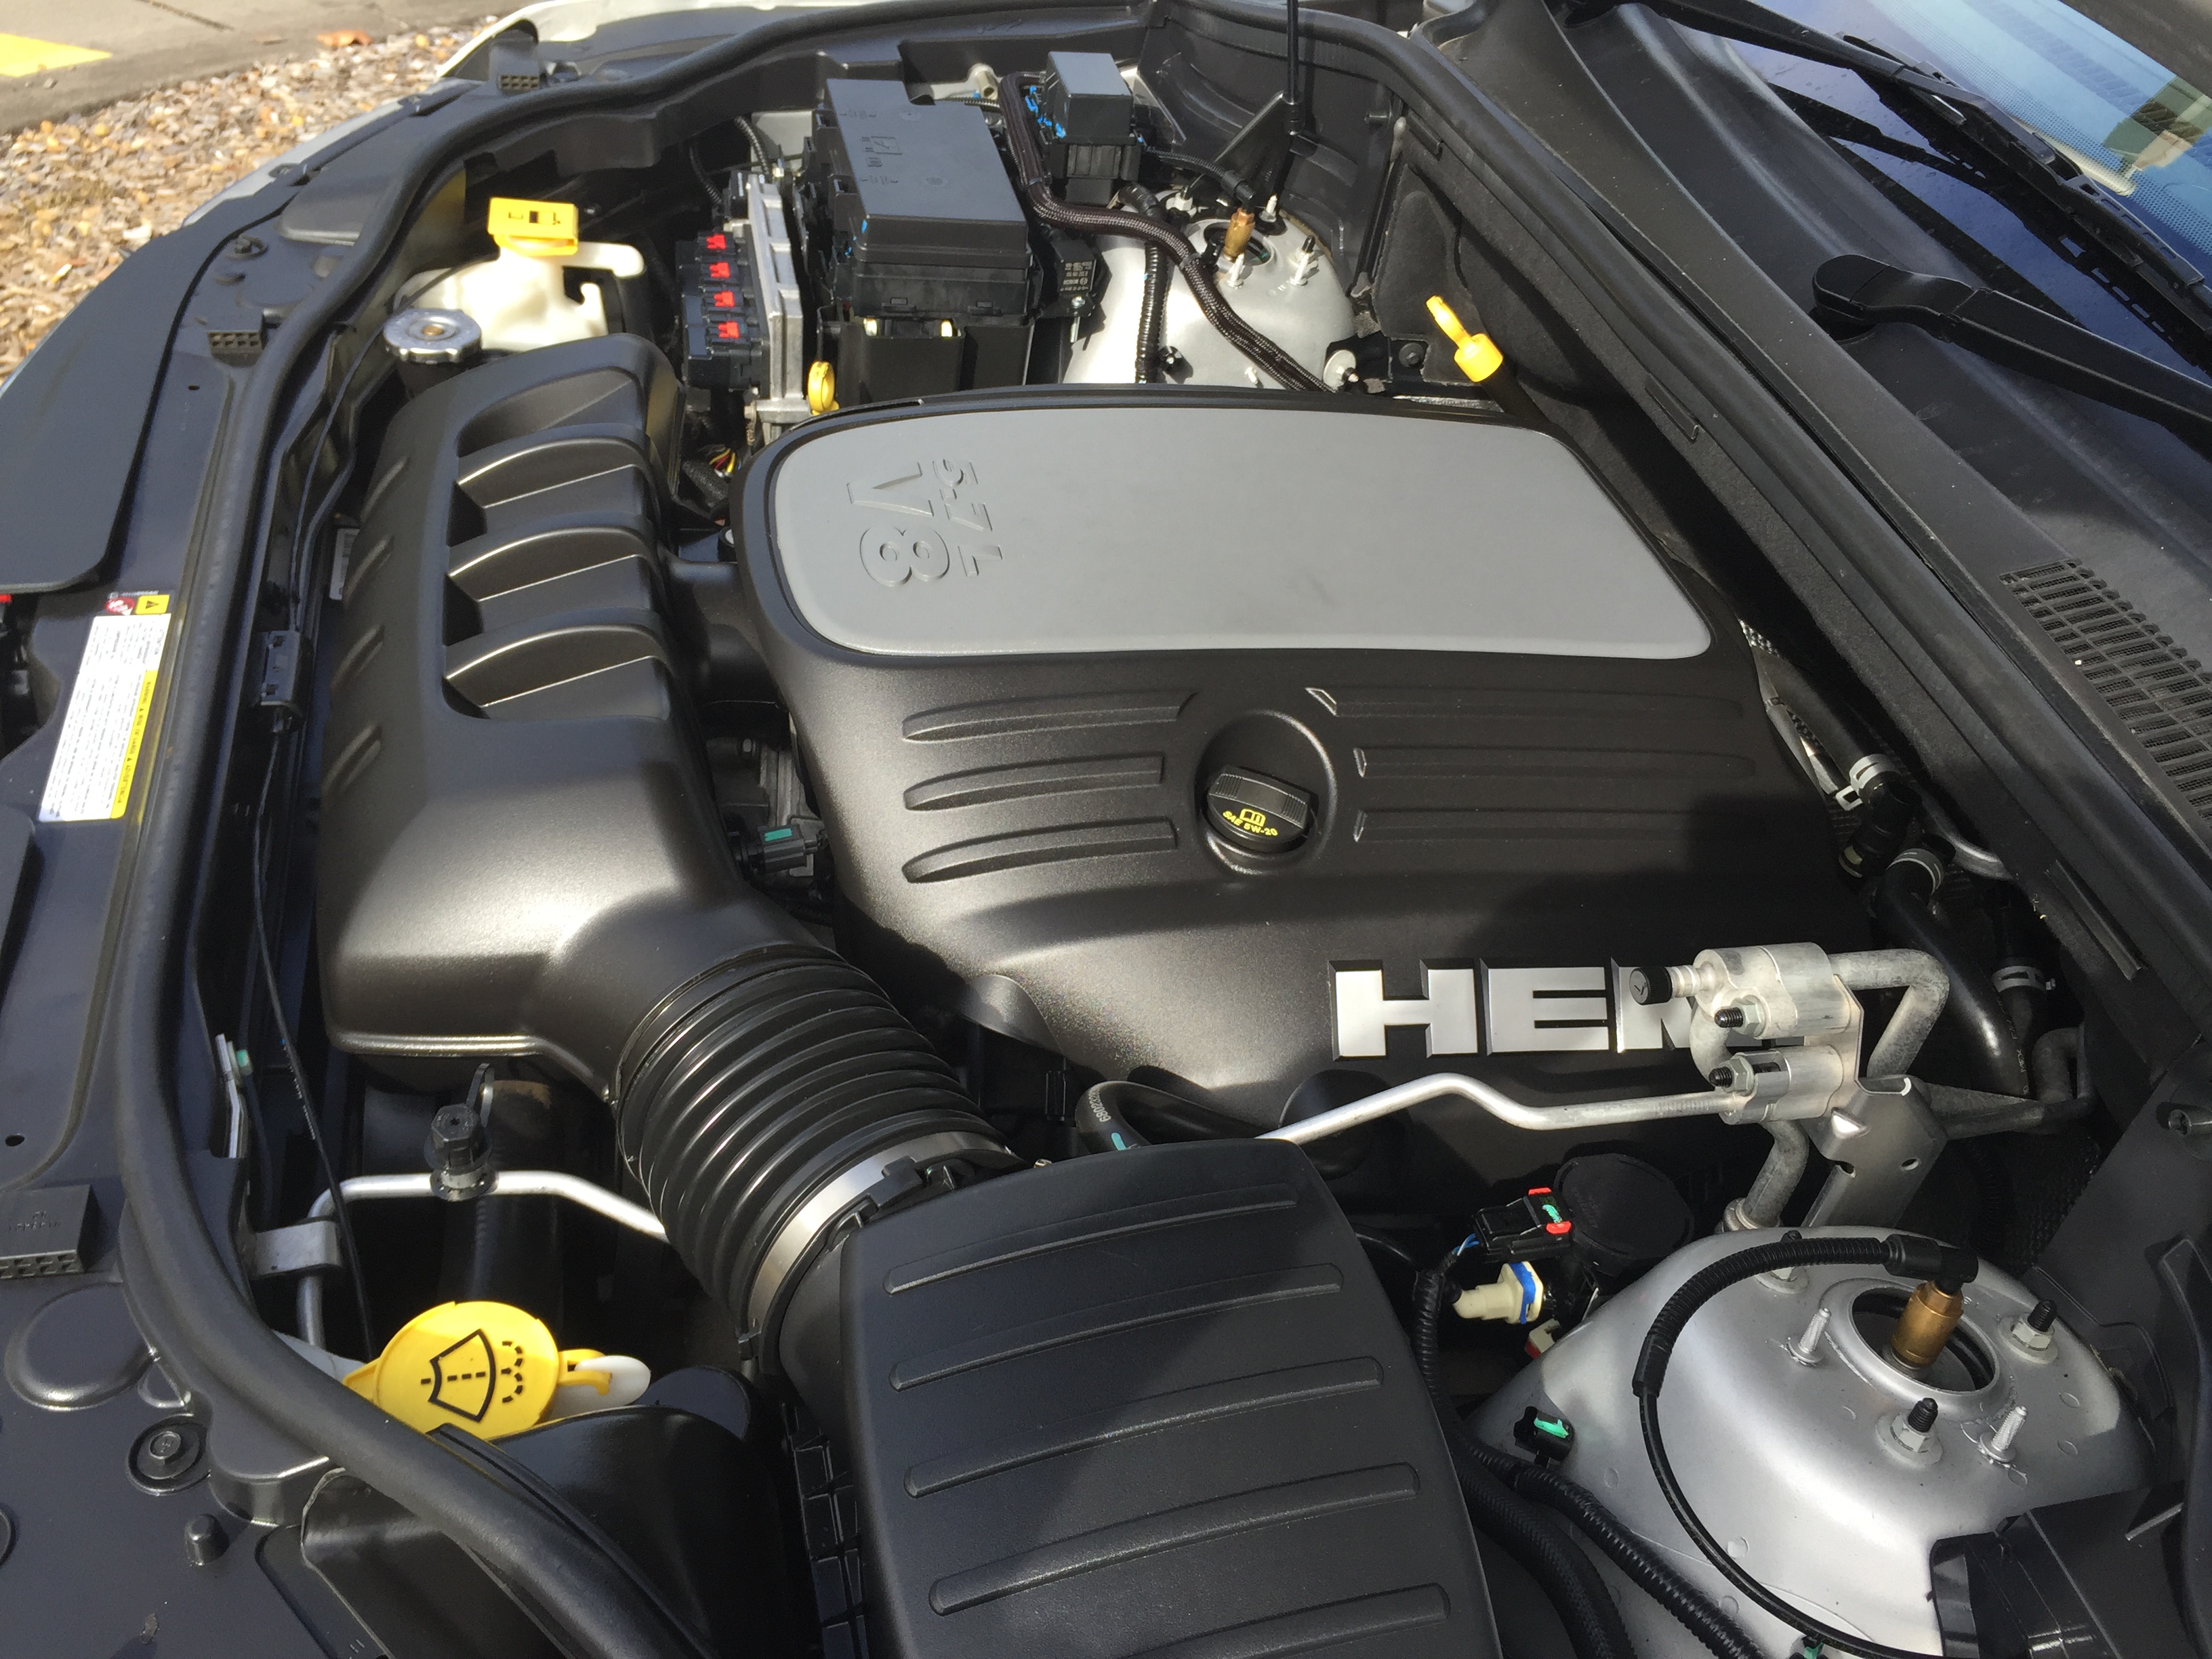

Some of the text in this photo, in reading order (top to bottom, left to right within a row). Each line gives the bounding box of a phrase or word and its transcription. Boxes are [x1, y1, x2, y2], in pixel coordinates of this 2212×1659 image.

[846, 462, 951, 588] V8
[1223, 810, 1278, 836] SAE 5W-20
